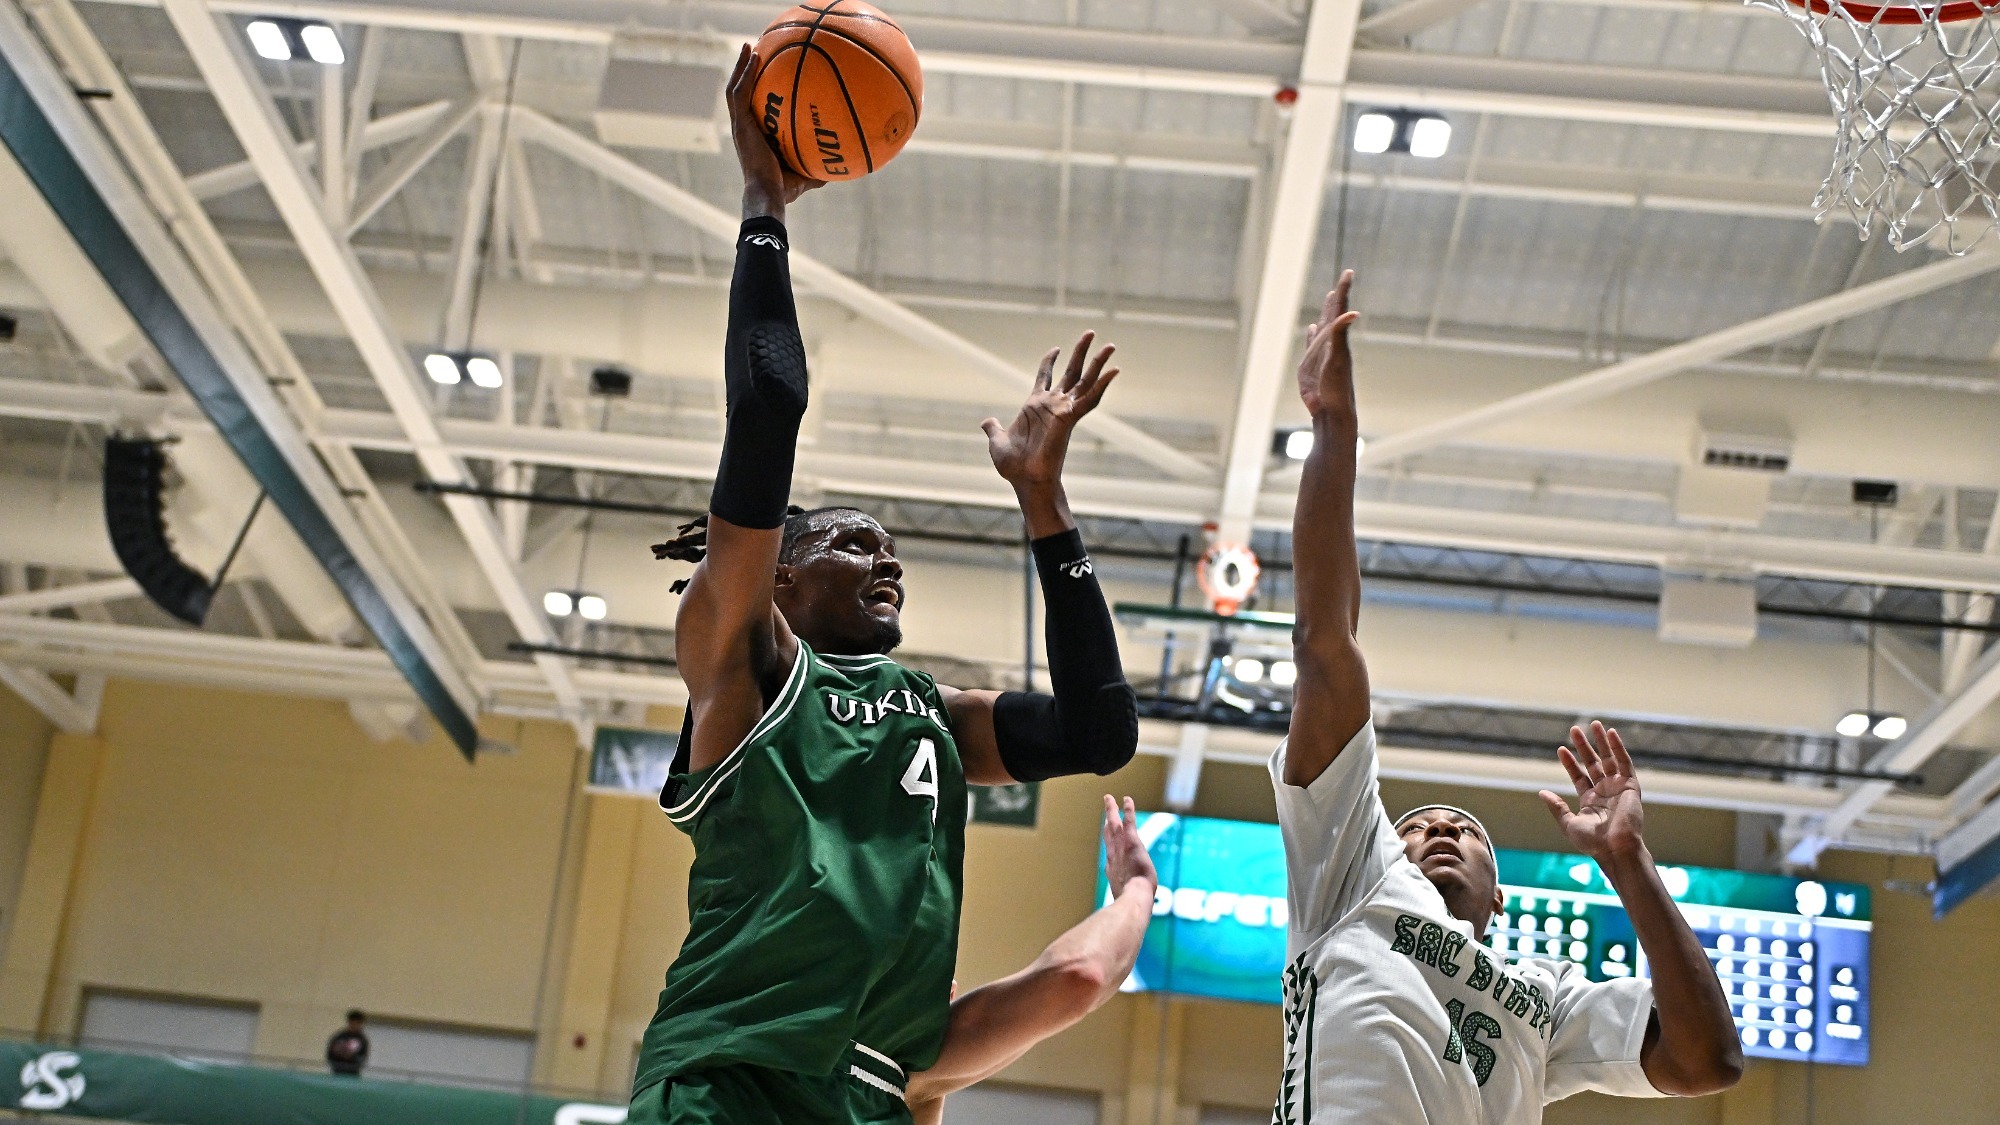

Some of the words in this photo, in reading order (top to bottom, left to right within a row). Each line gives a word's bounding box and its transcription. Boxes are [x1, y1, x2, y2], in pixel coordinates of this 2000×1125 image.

[815, 127, 849, 176] EVO
[900, 737, 939, 826] 4
[1390, 914, 1468, 978] SAC
[1443, 998, 1502, 1088] 16
